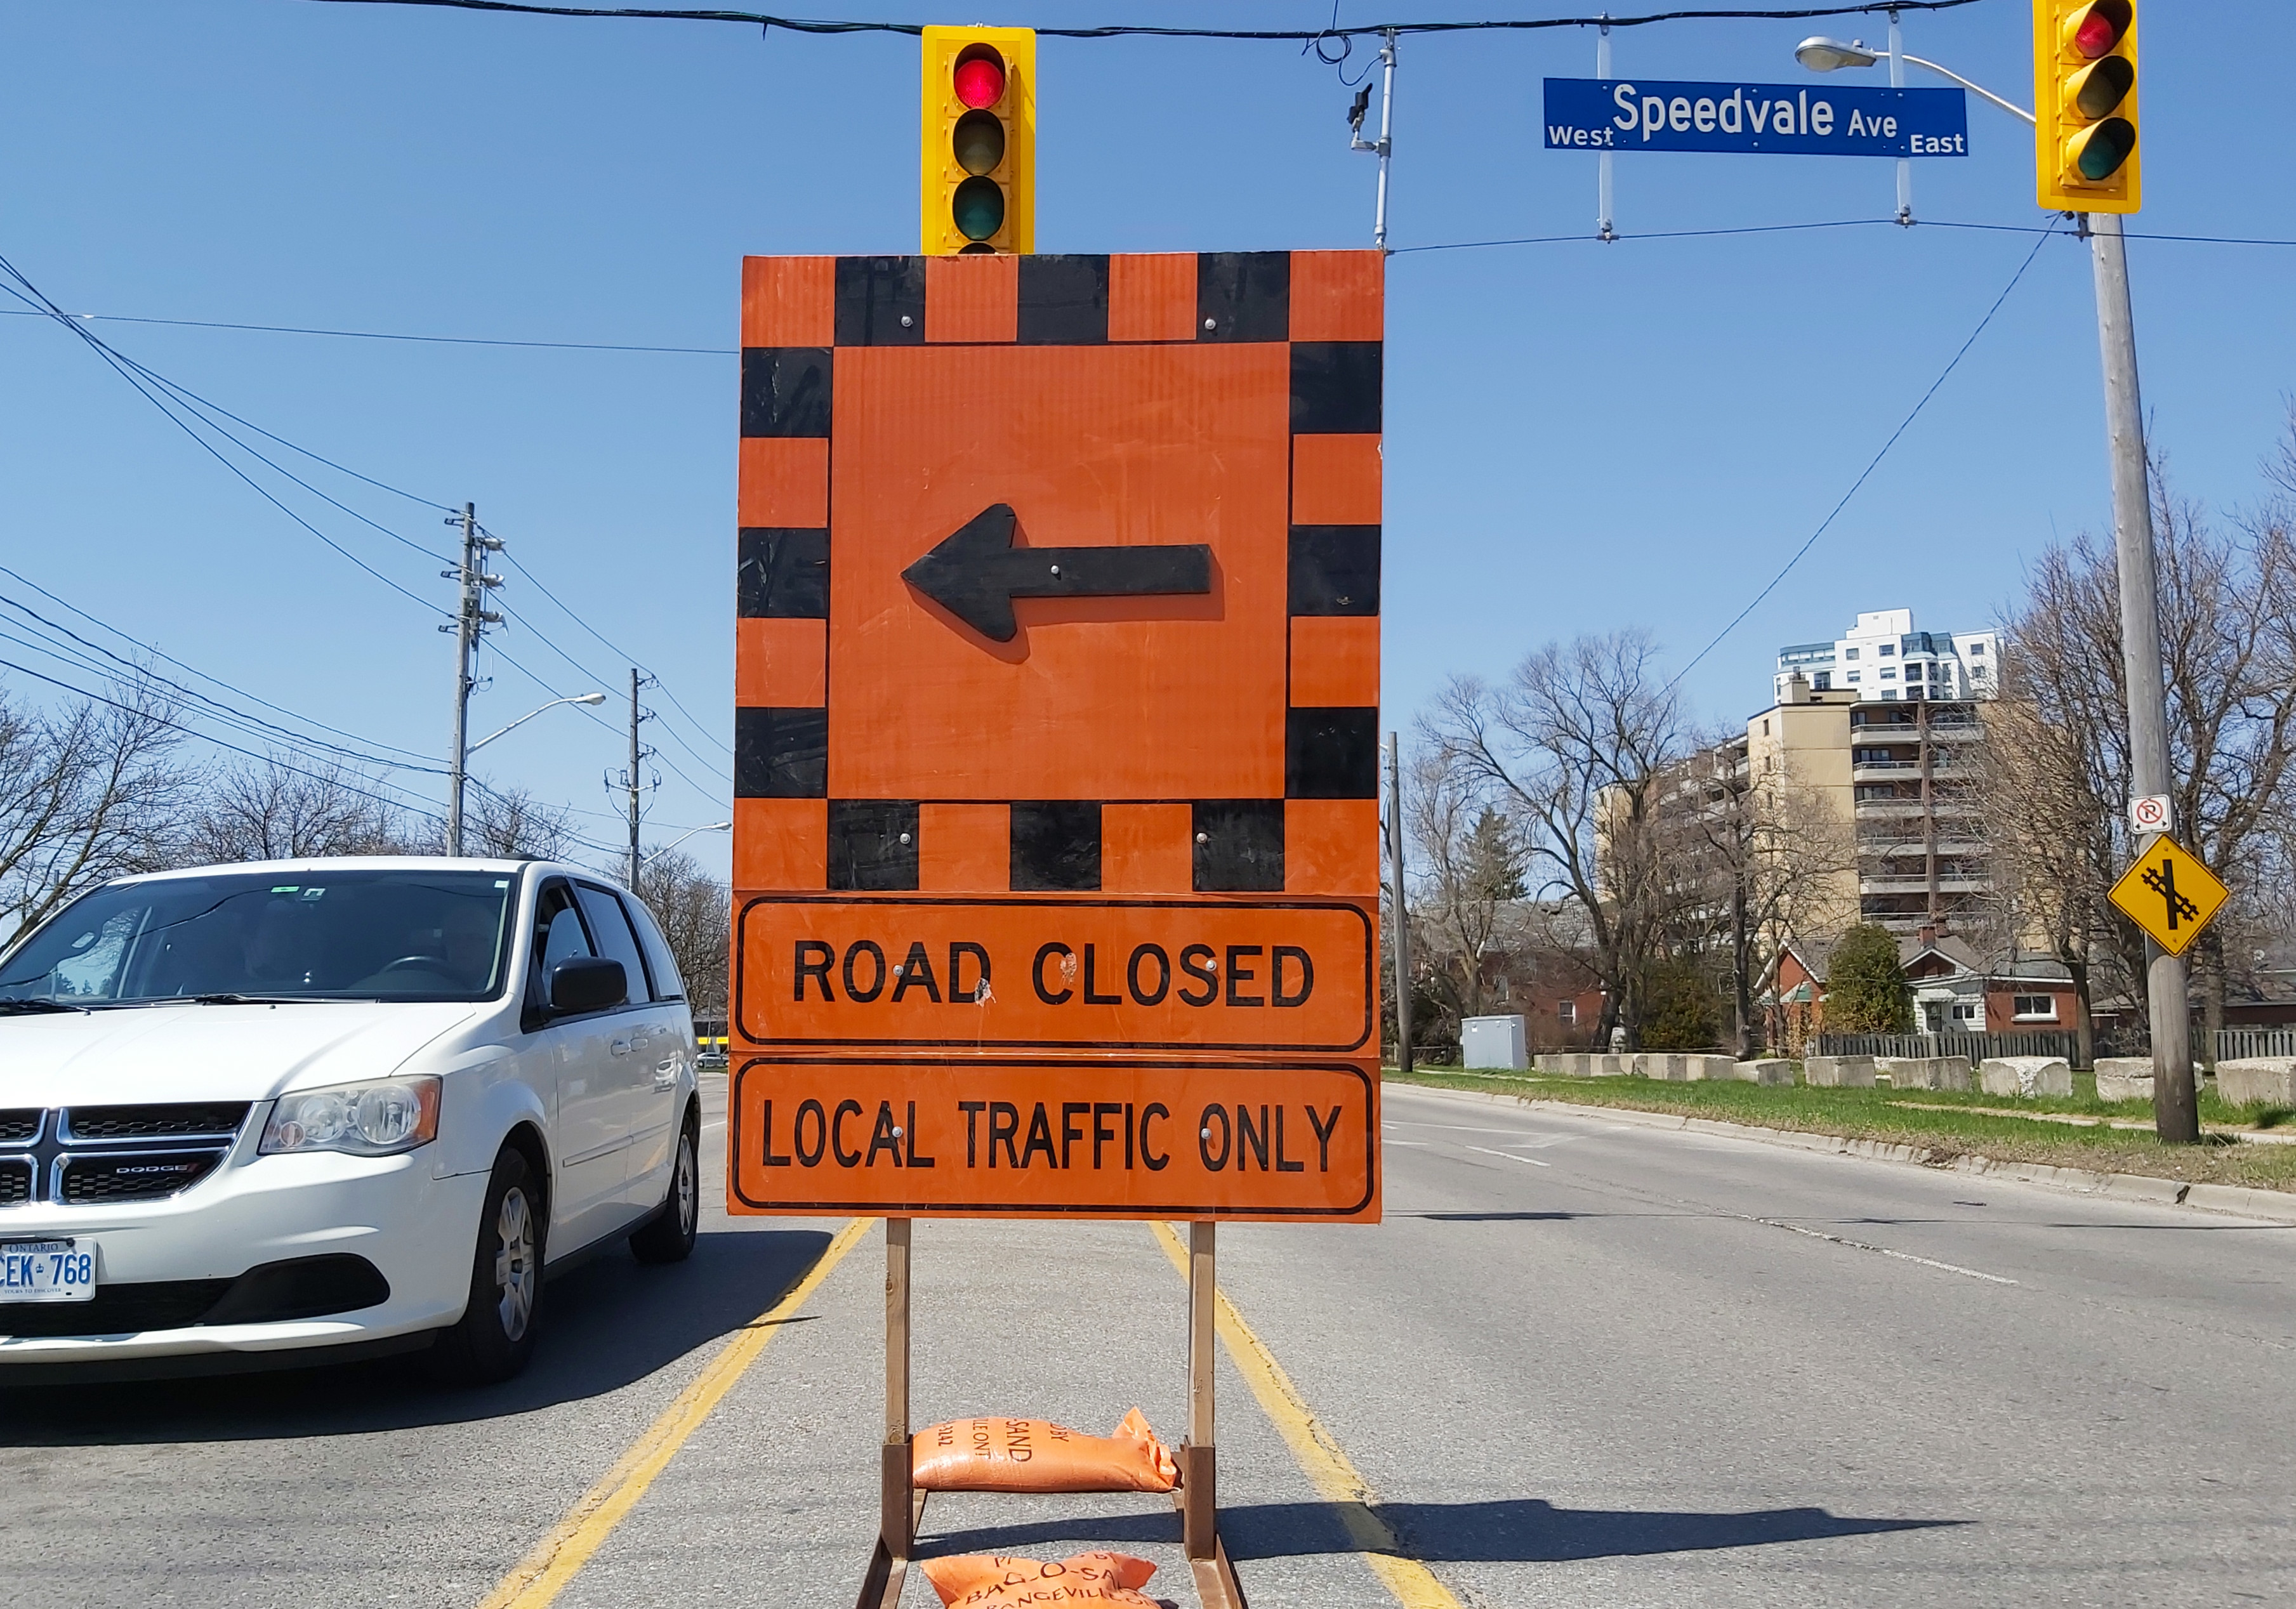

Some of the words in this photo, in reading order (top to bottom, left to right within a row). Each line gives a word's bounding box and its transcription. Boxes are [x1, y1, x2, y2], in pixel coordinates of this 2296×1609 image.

[1613, 83, 1833, 142] Speedvale
[1847, 109, 1897, 138] Ave
[1548, 126, 1614, 147] West
[1910, 134, 1964, 153] East
[793, 939, 992, 1004] ROAD
[1032, 942, 1315, 1008] CLOSED
[762, 1098, 935, 1168] LOCAL
[958, 1101, 1170, 1172] TRAFFIC
[1199, 1103, 1342, 1173] ONLY
[116, 1165, 188, 1174] DODGE
[9, 1244, 59, 1253] ONTARIO
[49, 1253, 91, 1285] 768
